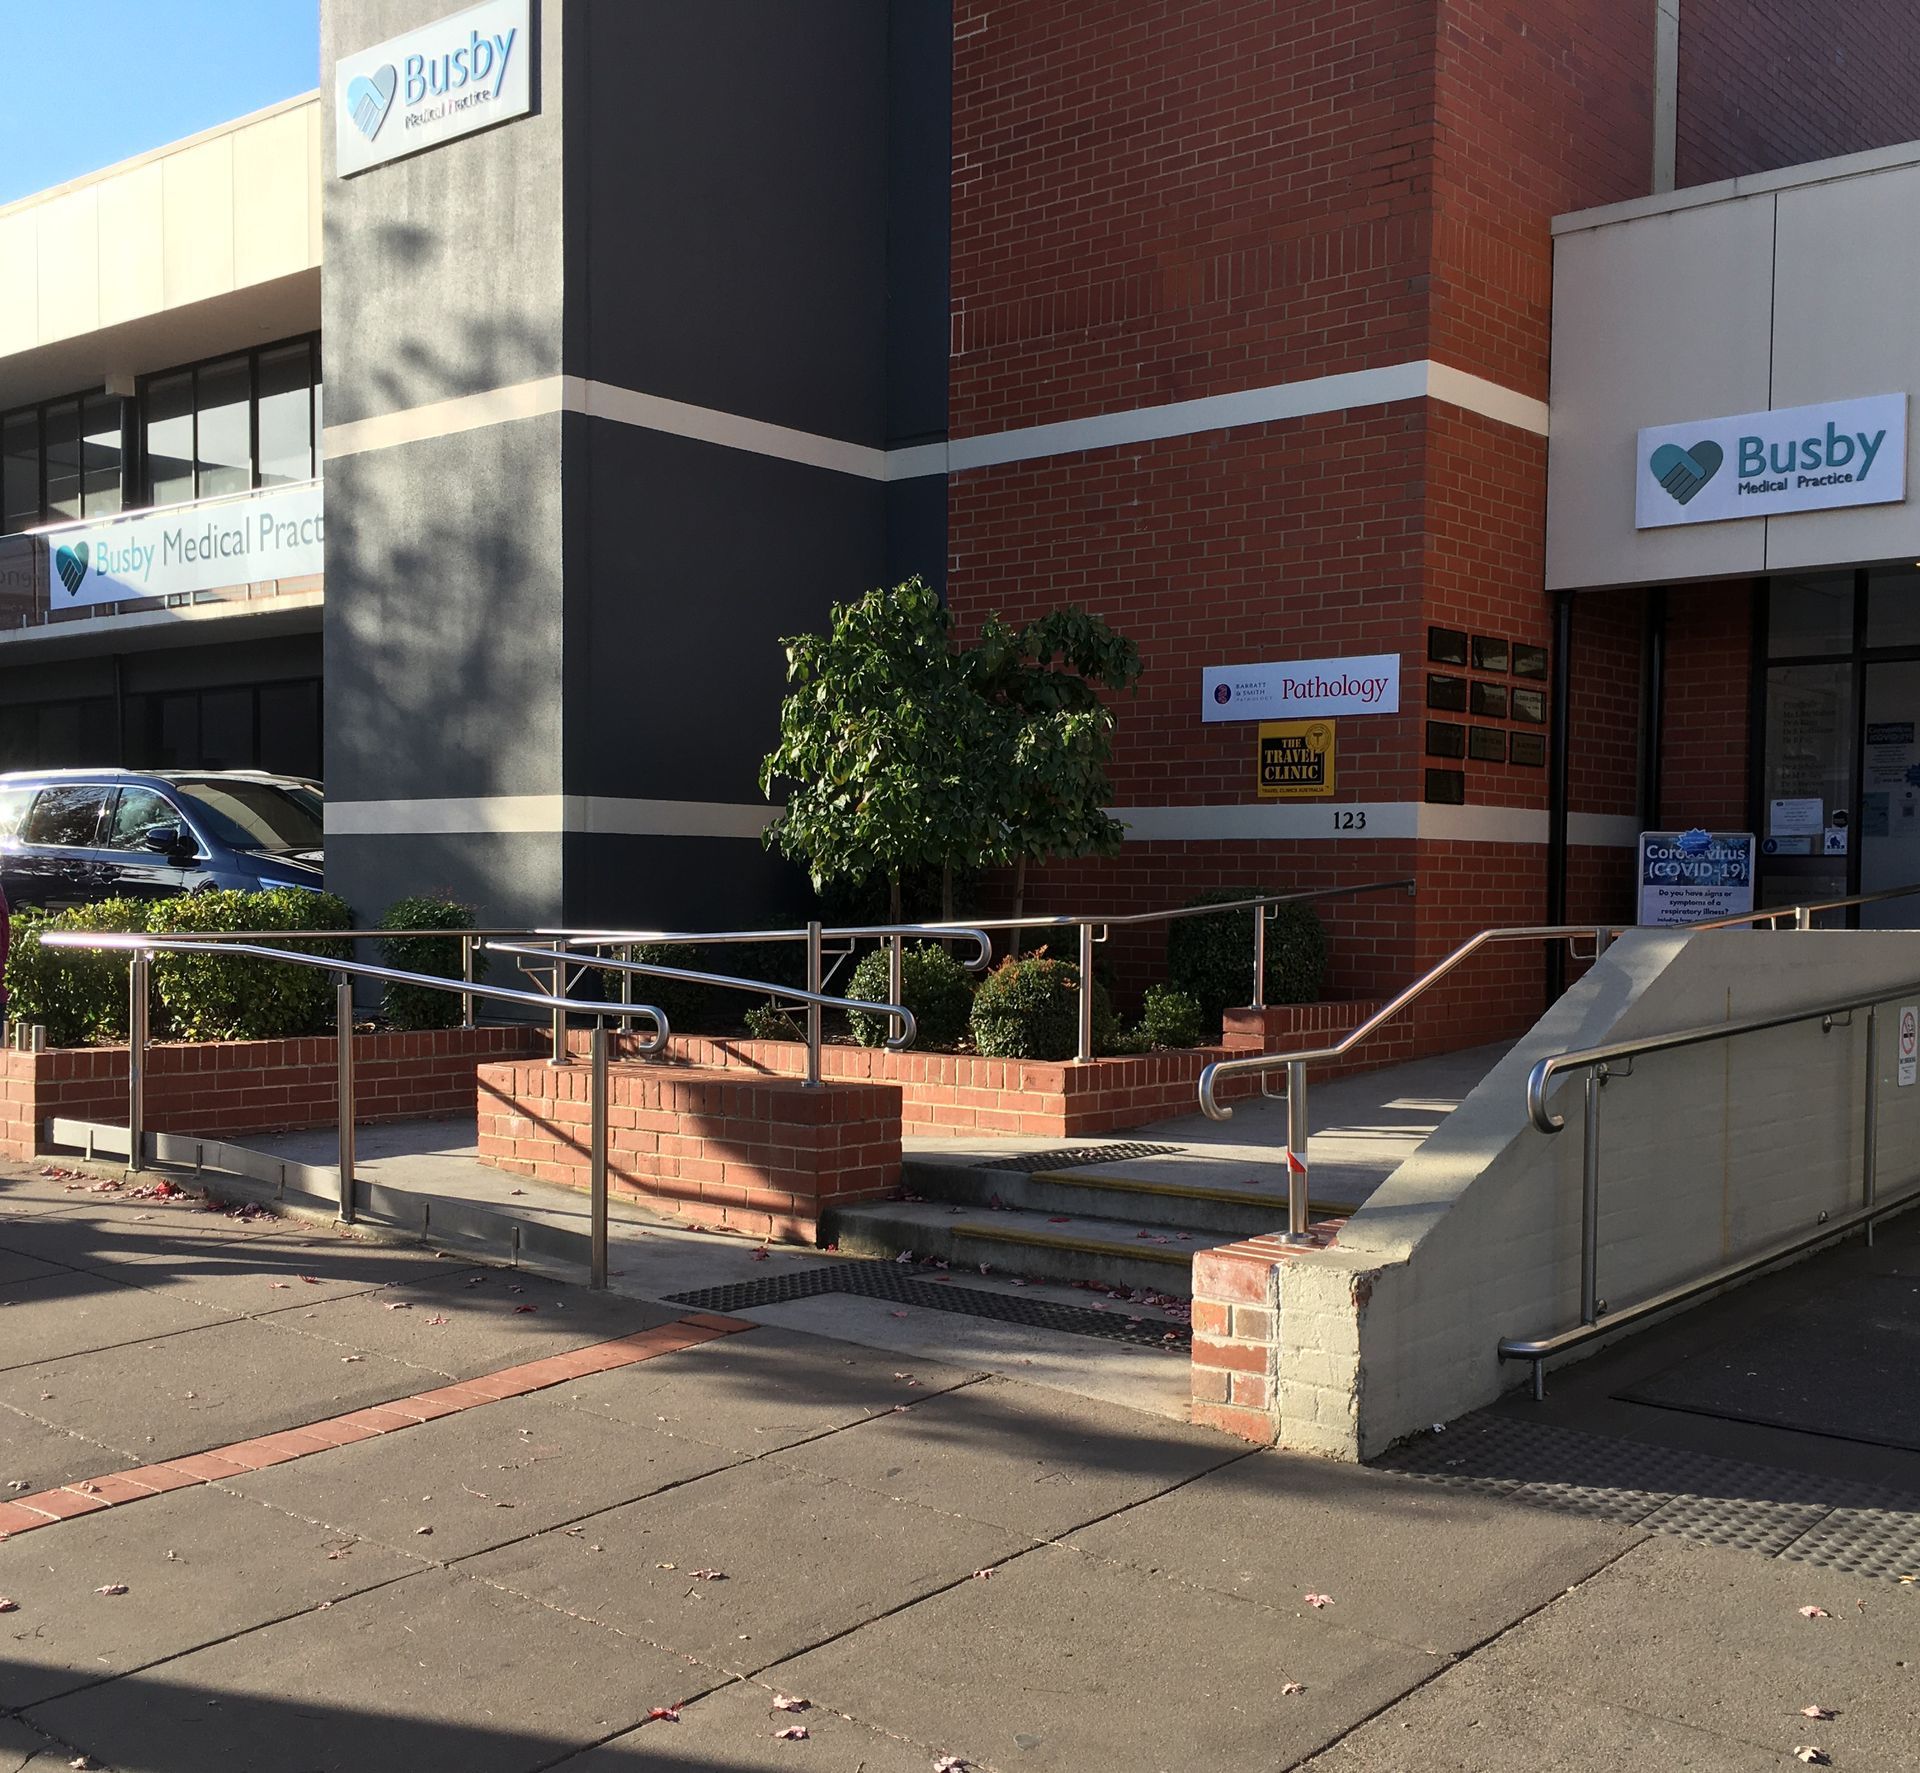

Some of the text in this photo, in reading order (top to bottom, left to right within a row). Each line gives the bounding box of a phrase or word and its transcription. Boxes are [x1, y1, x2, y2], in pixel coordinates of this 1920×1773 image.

[405, 27, 517, 106] Busby
[1737, 421, 1887, 482] Busby
[1738, 472, 1853, 495] Medical Practice
[96, 535, 155, 582] Busby
[163, 516, 251, 565] Medical
[1282, 674, 1389, 703] Pathology
[1281, 739, 1302, 748] THE
[1264, 749, 1318, 764] TRAVEL
[1264, 765, 1319, 780] CLINIC
[1333, 811, 1367, 830] 123
[1648, 861, 1746, 880] (COVID-19)
[1685, 889, 1703, 897] have
[1704, 890, 1723, 899] signs
[1661, 909, 1702, 917] respiratory
[1669, 900, 1706, 909] symptoms
